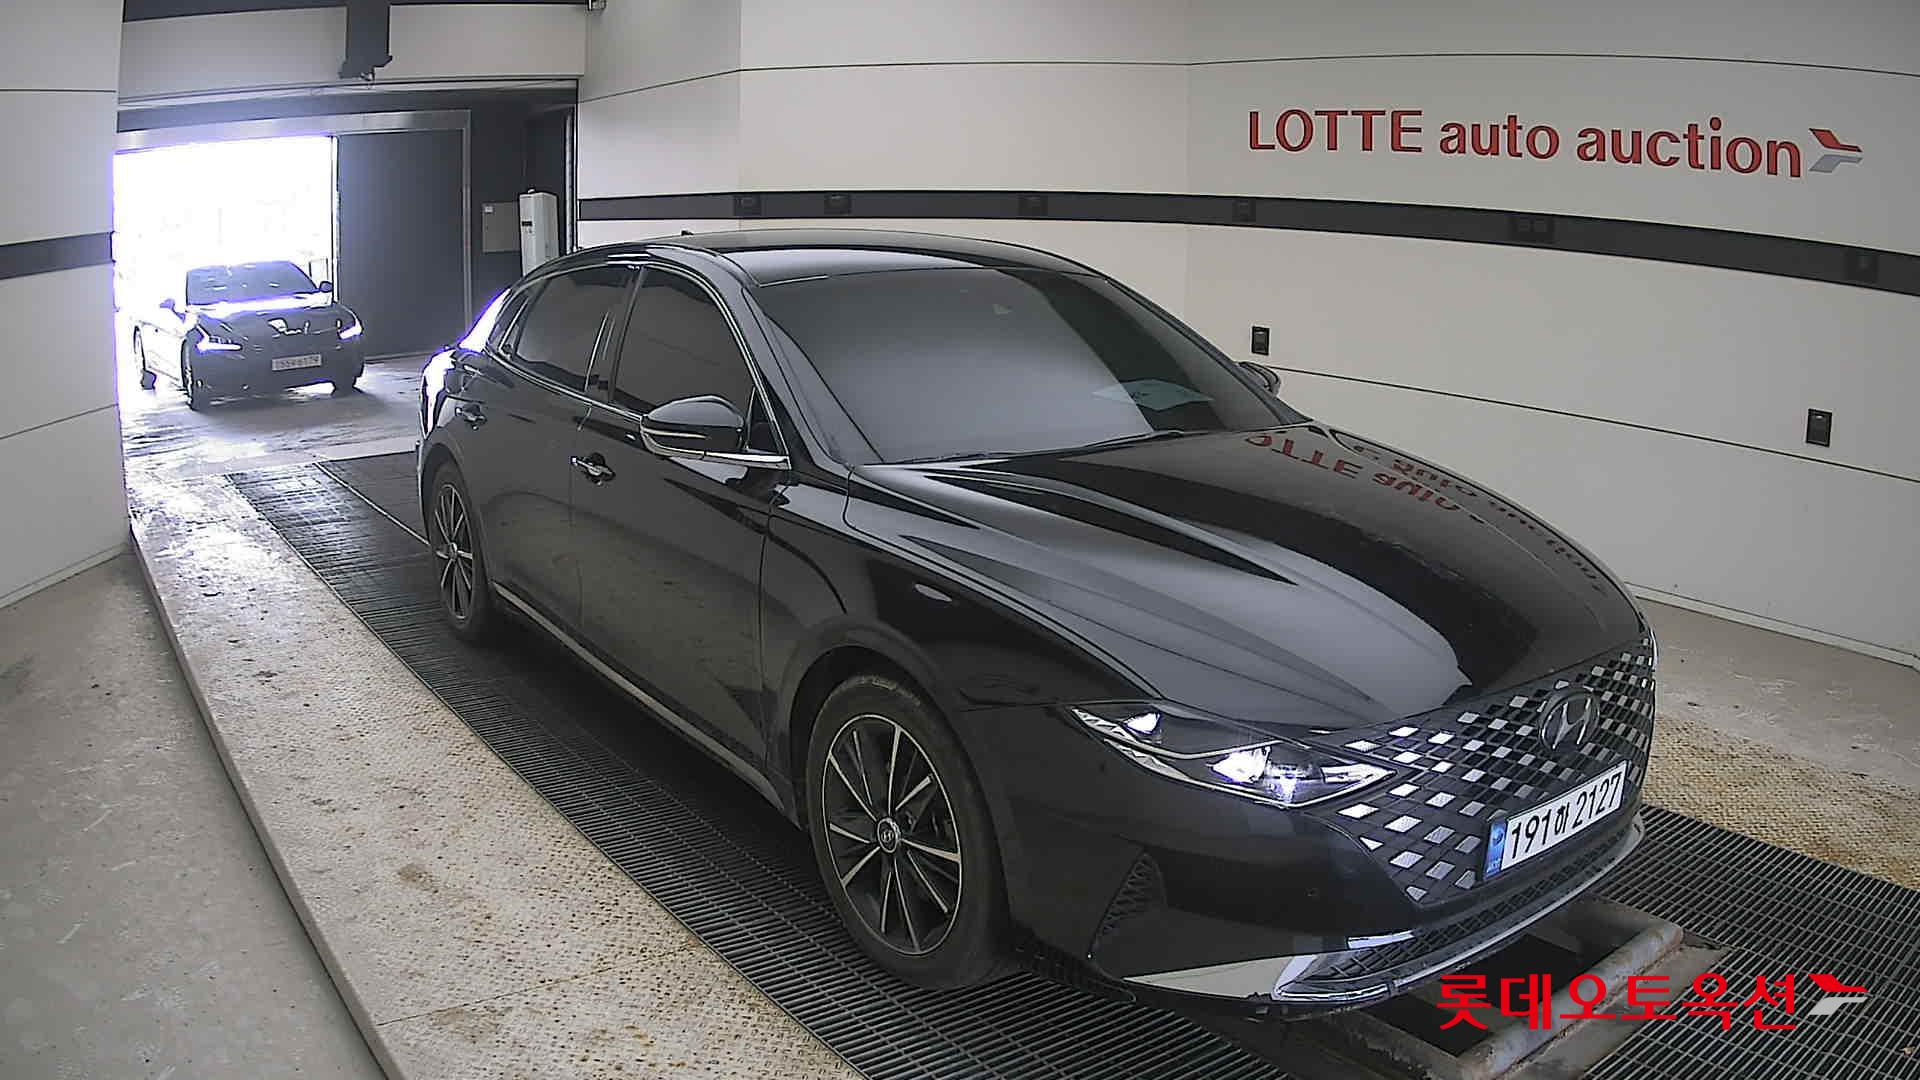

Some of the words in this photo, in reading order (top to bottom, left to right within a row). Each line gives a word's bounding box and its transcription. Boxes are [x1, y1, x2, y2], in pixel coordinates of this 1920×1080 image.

[1248, 109, 1424, 153] LOTTE
[1439, 115, 1561, 161] auto
[1576, 117, 1803, 177] auction
[1572, 771, 1623, 829] 2127
